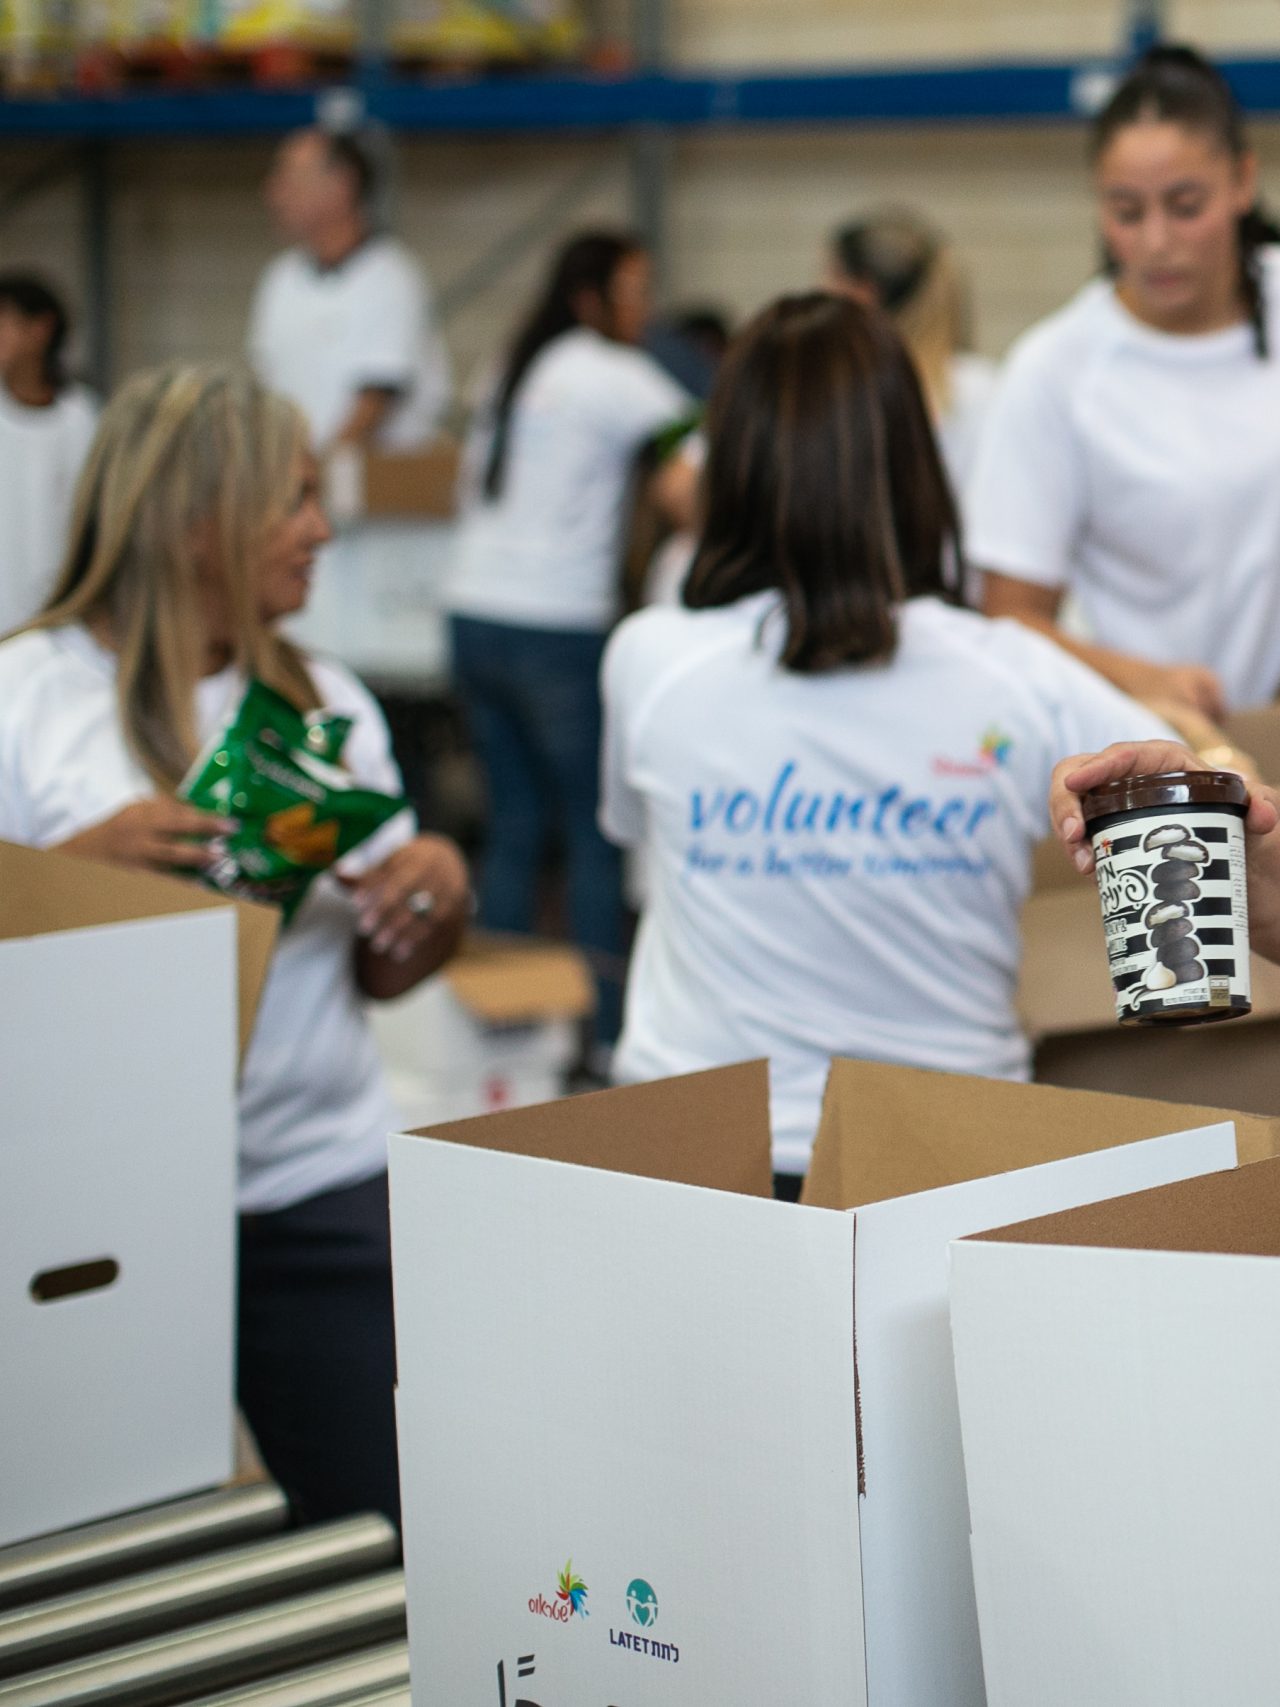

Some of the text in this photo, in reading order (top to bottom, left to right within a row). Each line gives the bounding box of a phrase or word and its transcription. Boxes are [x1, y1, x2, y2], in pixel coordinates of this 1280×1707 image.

[688, 758, 996, 838] volunteer
[528, 1593, 570, 1623] שטראוס
[609, 1627, 650, 1654] LATET
